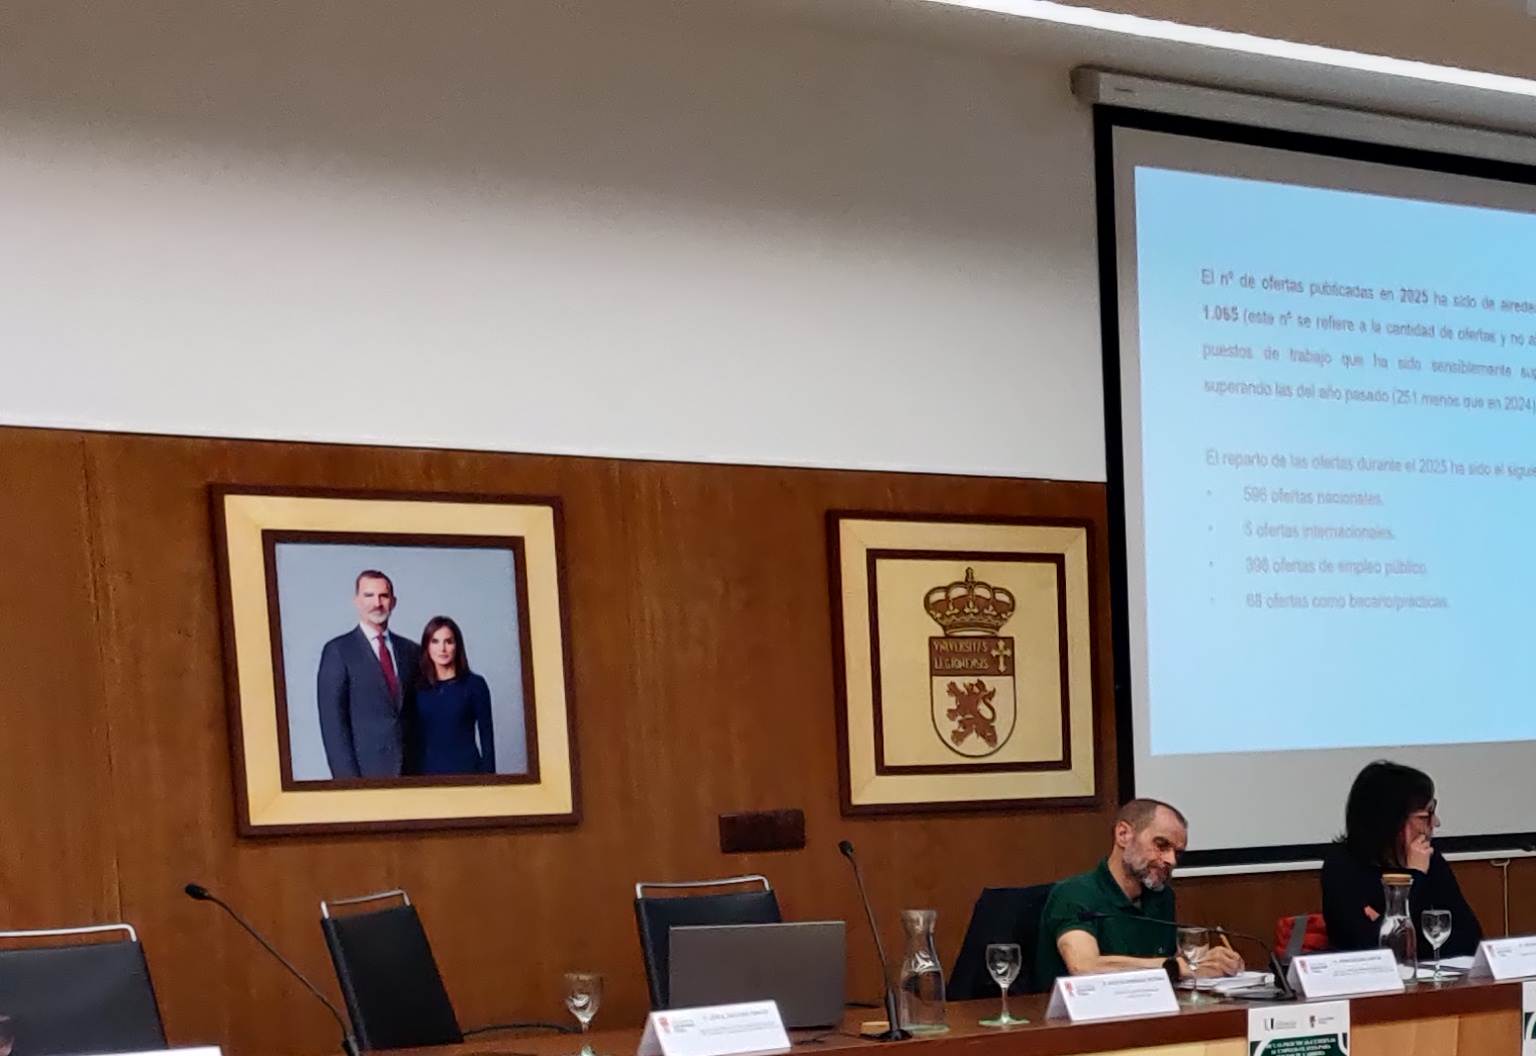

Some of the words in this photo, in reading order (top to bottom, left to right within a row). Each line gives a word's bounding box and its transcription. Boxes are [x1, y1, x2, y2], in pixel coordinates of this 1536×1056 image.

[1201, 268, 1214, 285] El
[1239, 273, 1256, 289] de
[1261, 275, 1304, 293] ofertas
[1309, 280, 1374, 300] publicadas
[1380, 289, 1394, 301] en
[1400, 288, 1428, 304] 2025
[1434, 291, 1448, 307] ha
[1453, 294, 1477, 309] sido
[1482, 296, 1495, 311] de
[1243, 308, 1275, 326] (este
[1297, 316, 1312, 329] se
[1316, 314, 1354, 332] refiere
[1359, 320, 1368, 333] a
[1372, 319, 1382, 334] la
[1386, 322, 1435, 338] cantidad
[1440, 326, 1453, 340] de
[1457, 327, 1496, 344] ofertas
[1511, 333, 1525, 346] no
[1202, 344, 1253, 361] puestos
[1263, 345, 1280, 361] de
[1290, 347, 1332, 368] trabajo
[1341, 354, 1364, 369] que
[1373, 352, 1388, 368] ha
[1398, 356, 1421, 371] sido
[1431, 359, 1512, 377] sensiblemente
[1204, 380, 1272, 397] superando
[1275, 382, 1293, 398] las
[1297, 383, 1315, 398] del
[1319, 386, 1341, 401] año
[1345, 388, 1389, 404] pasado
[1421, 394, 1460, 408] menos
[1463, 396, 1484, 412] que
[1487, 397, 1500, 409] en
[1206, 450, 1219, 466] El
[1222, 452, 1267, 469] reparto
[1271, 453, 1286, 468] de
[1290, 454, 1308, 469] las
[1312, 455, 1353, 471] ofertas
[1357, 457, 1401, 472] durante
[1405, 459, 1416, 472] el
[1419, 459, 1447, 475] 2025
[1451, 461, 1465, 475] ha
[1469, 461, 1491, 476] sido
[1495, 463, 1504, 476] el
[1271, 488, 1313, 504] ofertas
[1256, 523, 1299, 538] ofertas
[1272, 557, 1315, 573] ofertas
[1318, 558, 1334, 573] de
[1337, 559, 1382, 576] empleo
[1266, 593, 1309, 609] ofertas
[1312, 595, 1345, 609] como
